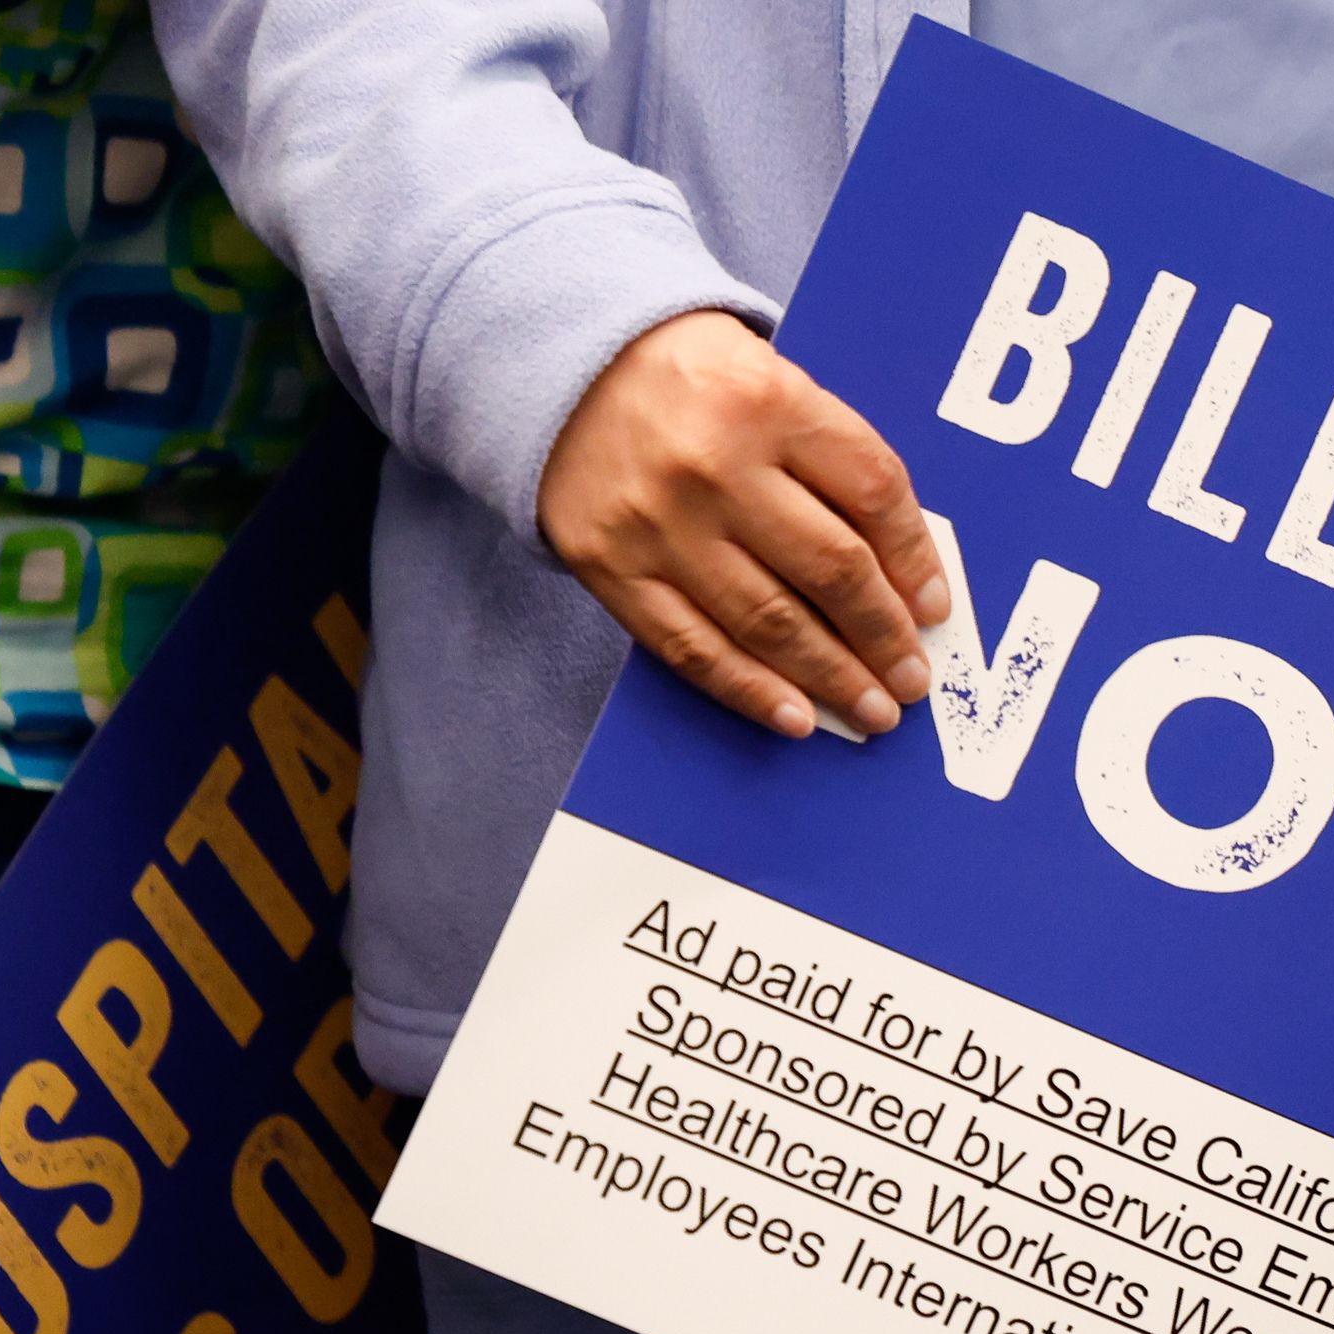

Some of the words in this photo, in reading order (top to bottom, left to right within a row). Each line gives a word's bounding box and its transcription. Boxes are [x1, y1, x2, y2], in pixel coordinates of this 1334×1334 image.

[627, 900, 717, 966] Ad
[720, 947, 852, 1024] paid
[862, 993, 942, 1060] for
[951, 1030, 1024, 1103] by
[1037, 1068, 1176, 1162] Save
[636, 985, 946, 1148] Sponsored
[955, 1116, 1027, 1189] by
[1039, 1155, 1244, 1274] Service
[512, 1102, 826, 1270] Employees
[599, 1053, 903, 1216] Healthcare
[924, 1184, 1149, 1320] Workers
